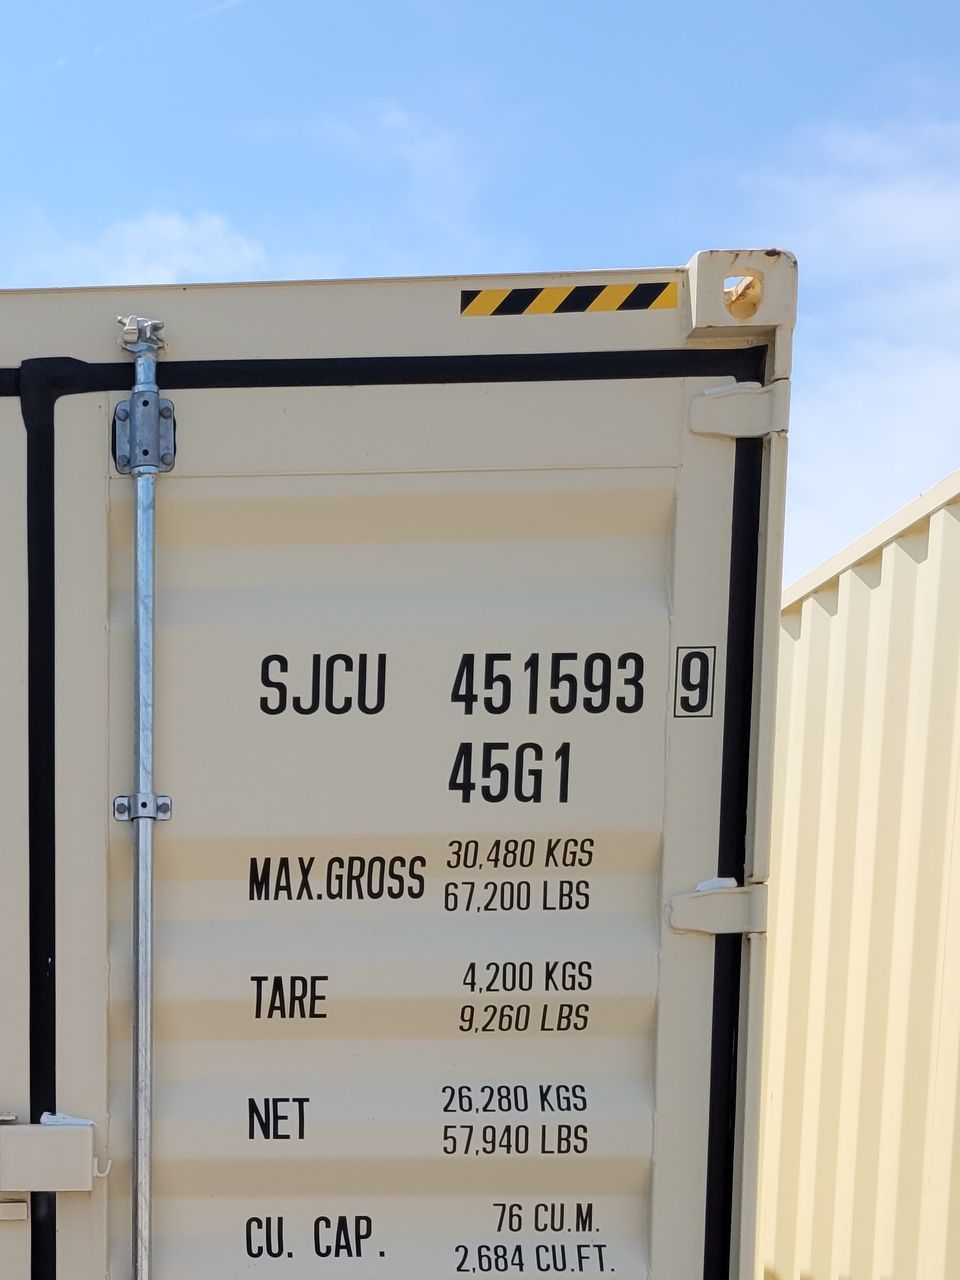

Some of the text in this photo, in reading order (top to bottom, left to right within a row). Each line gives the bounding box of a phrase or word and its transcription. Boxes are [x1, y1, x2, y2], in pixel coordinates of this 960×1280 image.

[260, 652, 709, 715] SJCU 451593 9
[449, 742, 570, 803] 45G1
[447, 839, 594, 869] 30,480 KGS
[249, 856, 426, 900] MAX.GROSS
[445, 881, 589, 912] 67,200 LBS
[463, 962, 591, 993] 4,200 KGS
[251, 976, 328, 1018] TARE
[460, 1004, 589, 1033] 9,260 LBS
[442, 1085, 586, 1113] 26,280 KGS
[249, 1098, 309, 1139] NET
[444, 1125, 587, 1155] 57,940 LBS
[493, 1204, 522, 1232] 76
[246, 1216, 384, 1258] CU. CAP.
[455, 1245, 614, 1273] 2,684 CU.FT.
